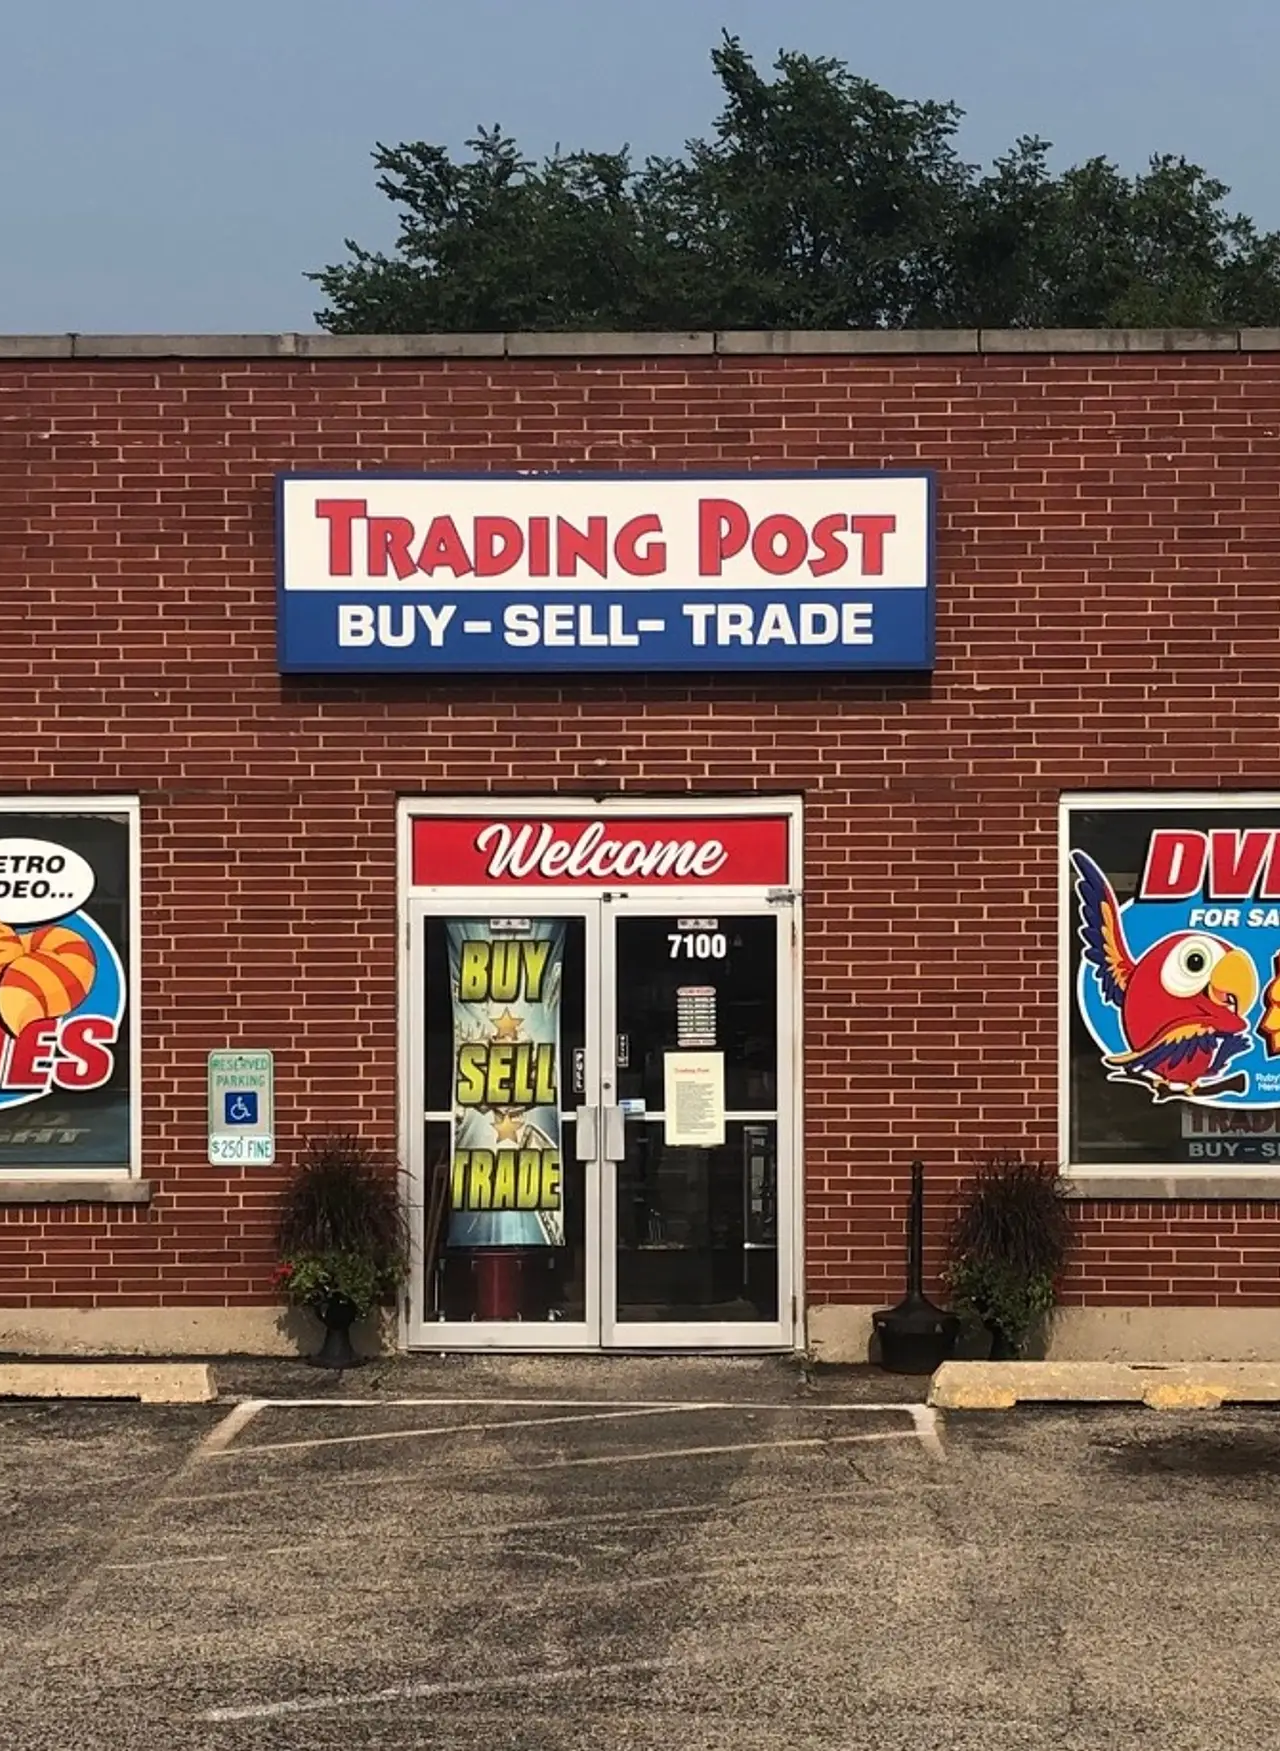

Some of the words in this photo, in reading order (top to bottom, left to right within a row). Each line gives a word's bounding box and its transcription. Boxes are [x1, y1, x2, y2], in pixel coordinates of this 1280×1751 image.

[315, 498, 666, 580] TRADING
[698, 498, 895, 579] POST
[337, 605, 456, 648] BUY
[683, 604, 873, 646] TRADE
[475, 821, 729, 879] Welcome
[1189, 908, 1240, 928] FOR
[667, 933, 727, 959] 7100
[459, 939, 551, 1003] BUY
[211, 1057, 269, 1071] RESERVED
[216, 1075, 265, 1087] PARKING
[455, 1042, 558, 1106] SELL
[211, 1140, 243, 1158] $250
[248, 1140, 272, 1158] FINE
[1189, 1143, 1239, 1157] BUY
[451, 1148, 562, 1211] TRADE
